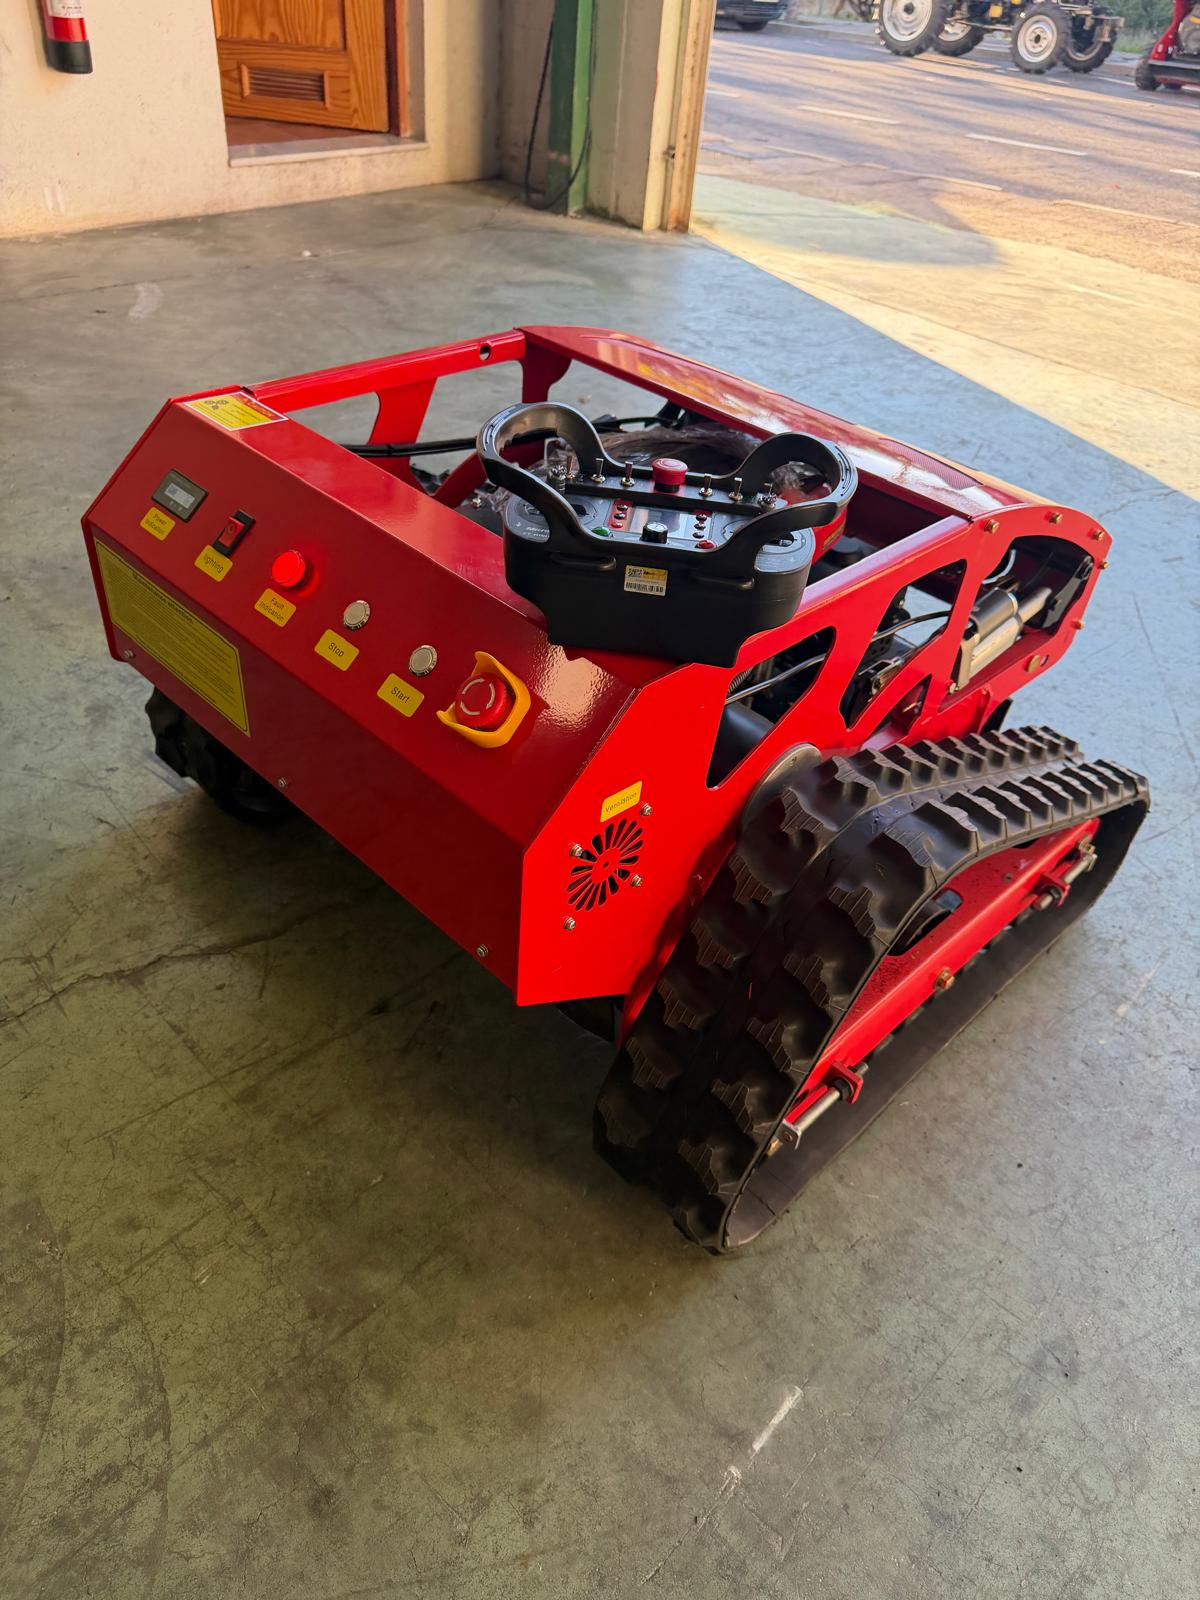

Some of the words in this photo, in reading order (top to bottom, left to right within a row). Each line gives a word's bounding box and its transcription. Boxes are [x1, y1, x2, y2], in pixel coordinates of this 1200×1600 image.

[271, 597, 285, 610] Fault
[328, 642, 344, 657] Stop
[391, 686, 410, 704] Start
[605, 792, 637, 812] Ventilation
